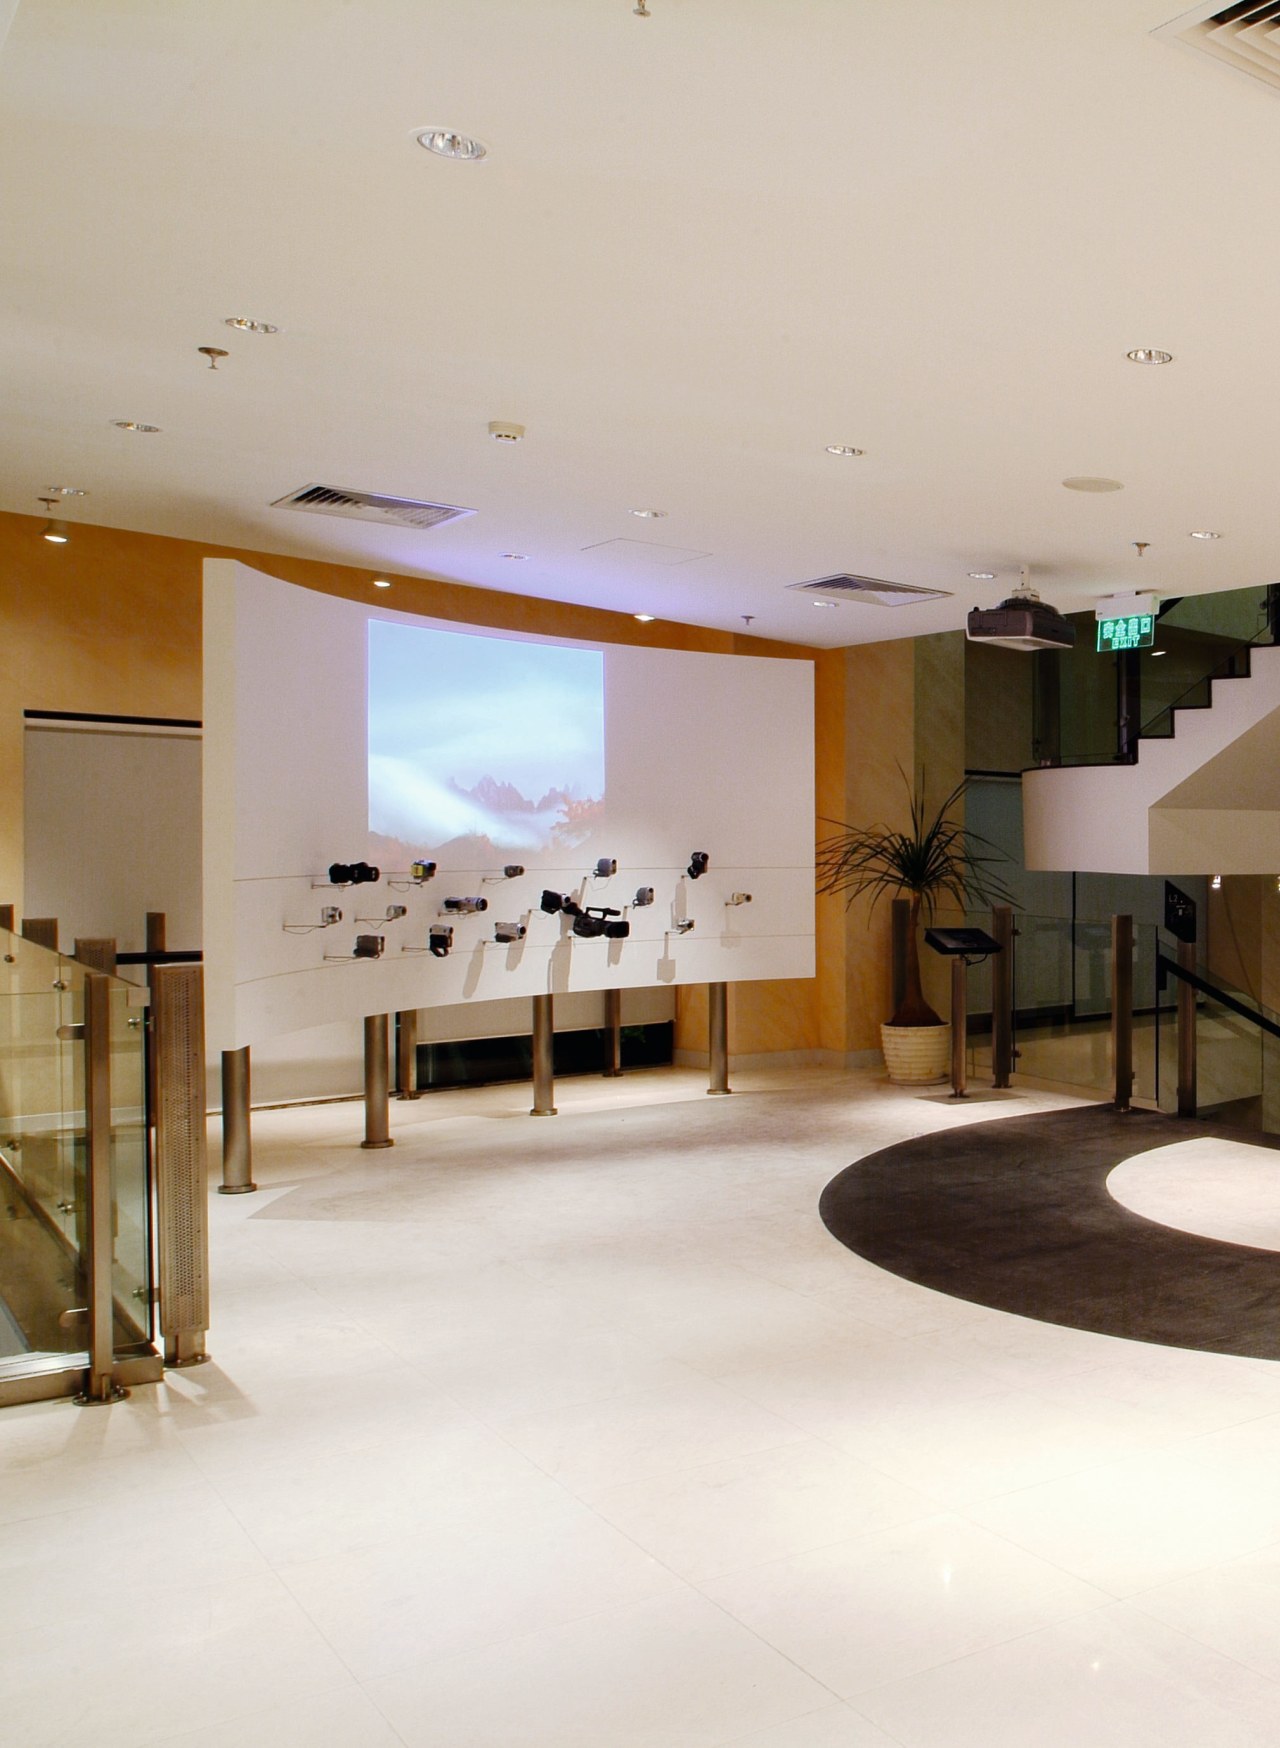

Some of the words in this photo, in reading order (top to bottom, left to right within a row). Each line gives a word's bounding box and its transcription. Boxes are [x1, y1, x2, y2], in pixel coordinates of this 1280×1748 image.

[1103, 617, 1151, 639] 安全出口
[1111, 634, 1140, 650] EXIT
